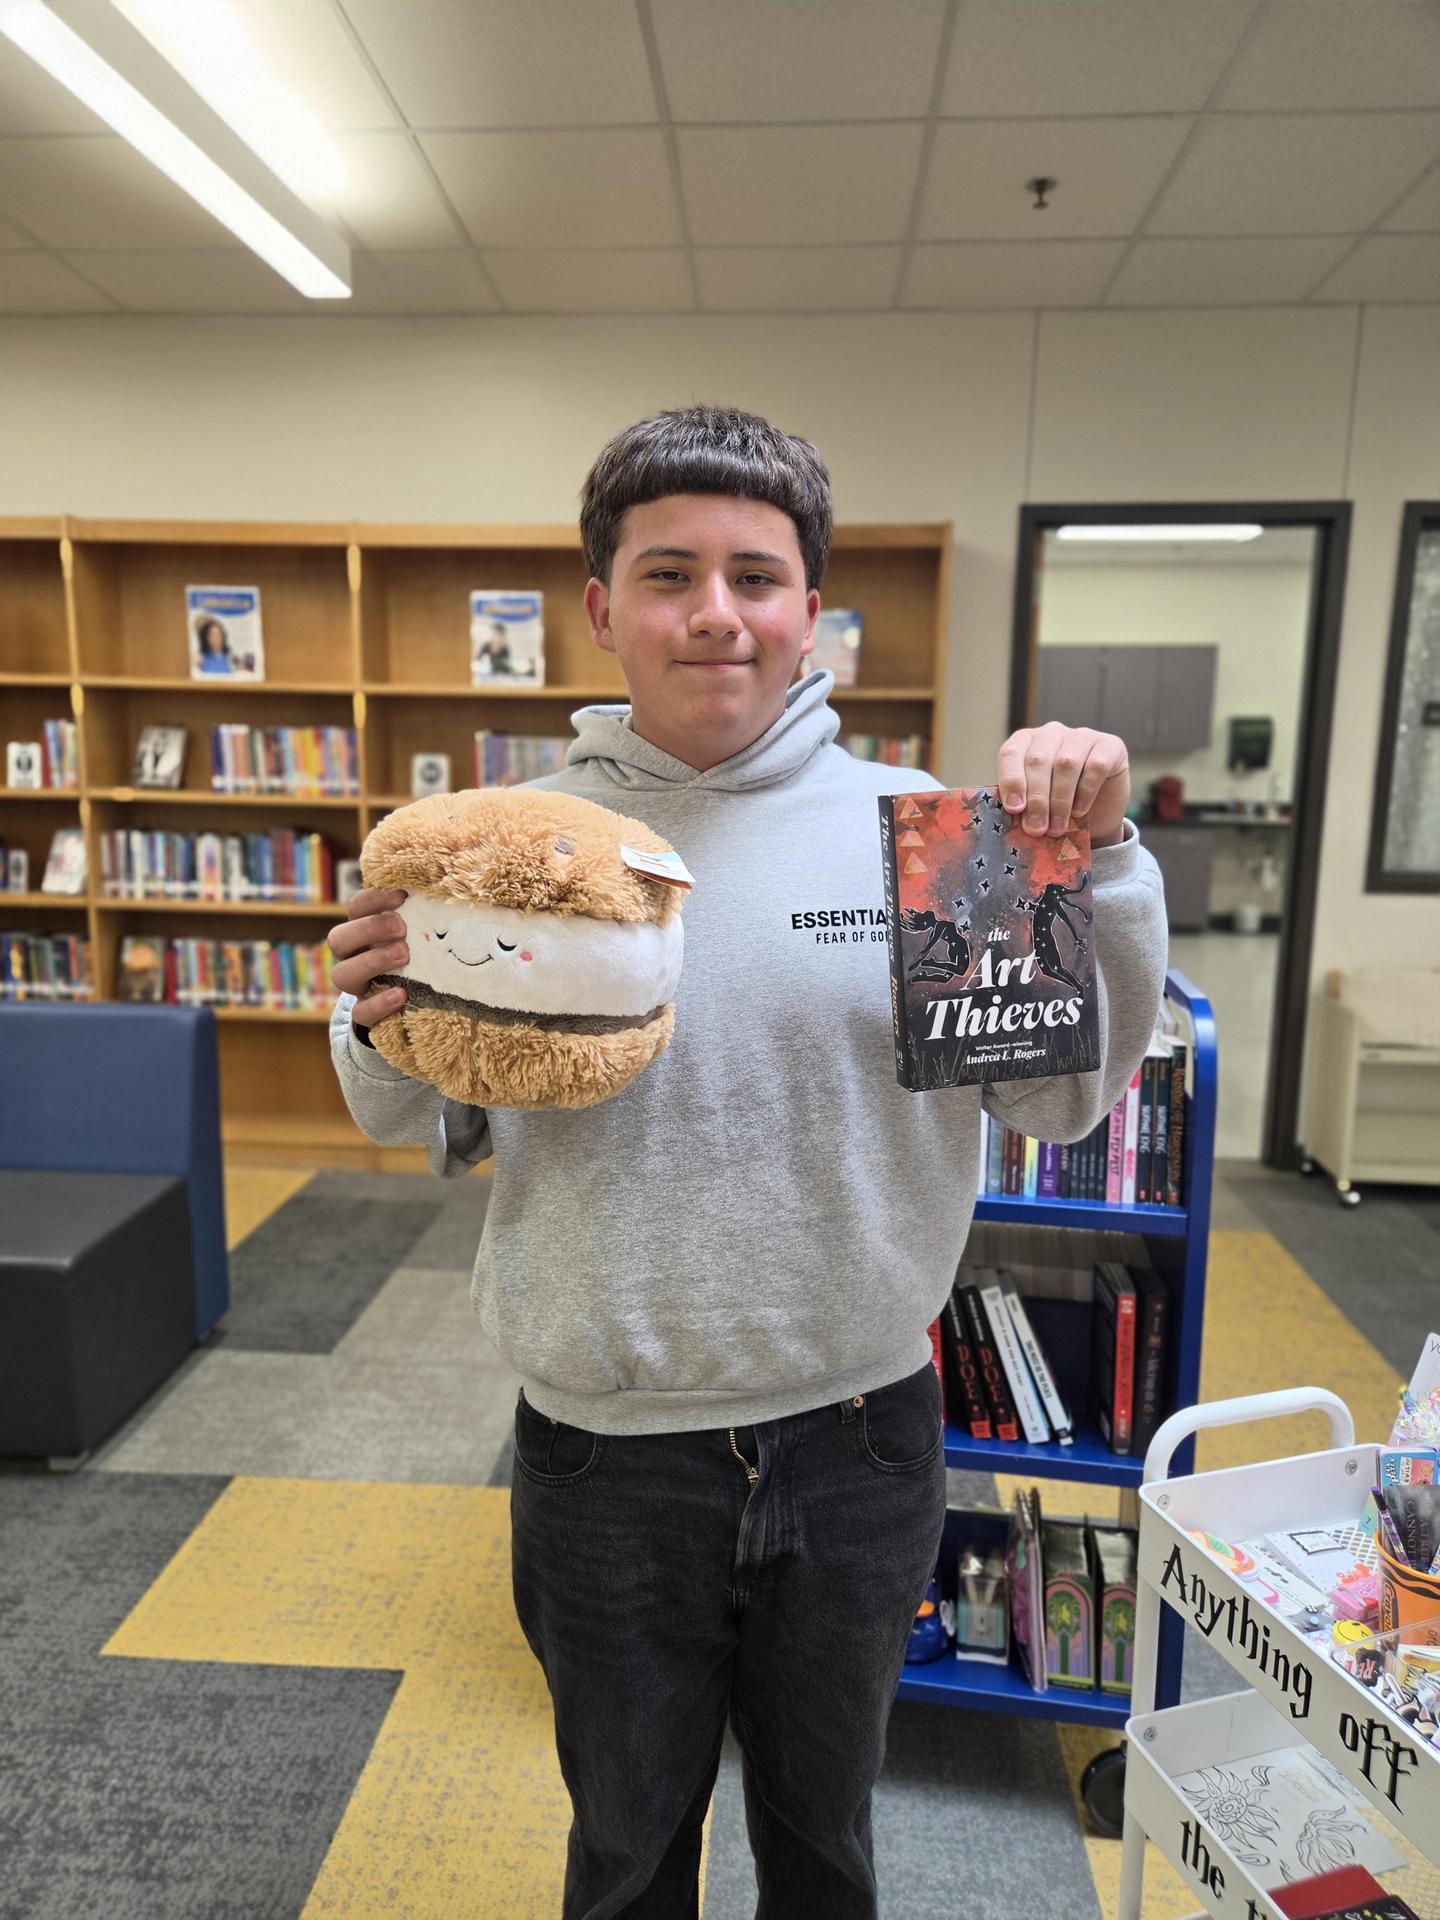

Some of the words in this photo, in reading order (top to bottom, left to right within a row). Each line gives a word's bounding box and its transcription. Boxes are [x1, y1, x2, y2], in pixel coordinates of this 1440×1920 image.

[881, 815, 889, 851] The
[884, 853, 892, 889] Art
[816, 932, 846, 944] FEAR
[852, 931, 865, 943] OF
[886, 892, 895, 962] Thieves
[988, 928, 1011, 942] the
[959, 948, 1041, 991] Art
[891, 975, 900, 1038] Rogers
[924, 994, 1084, 1041] Thieves
[966, 1053, 1000, 1065] Andrea
[1002, 1051, 1011, 1061] L.
[1013, 1048, 1047, 1060] Rogers
[1407, 1501, 1416, 1555] CANNOT
[1160, 1543, 1313, 1718] Anything
[1339, 1712, 1419, 1815] off
[1180, 1819, 1226, 1900] the
